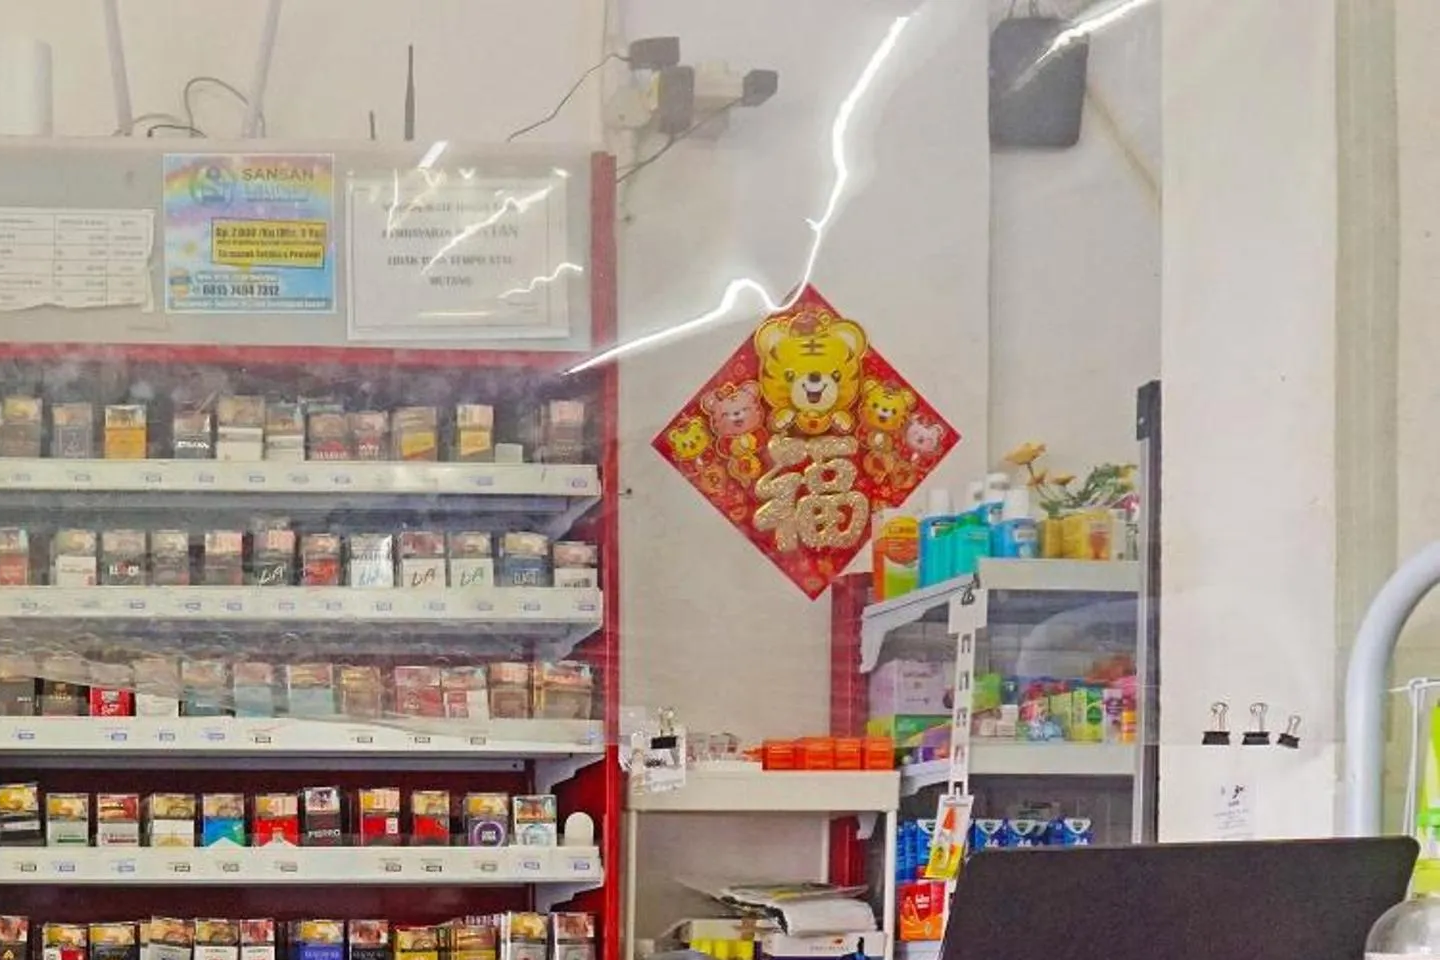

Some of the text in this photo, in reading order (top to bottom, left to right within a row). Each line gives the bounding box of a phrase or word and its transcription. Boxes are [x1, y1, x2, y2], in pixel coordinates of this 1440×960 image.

[241, 168, 315, 183] SANSAN
[412, 566, 437, 586] LA
[460, 566, 486, 586] LA
